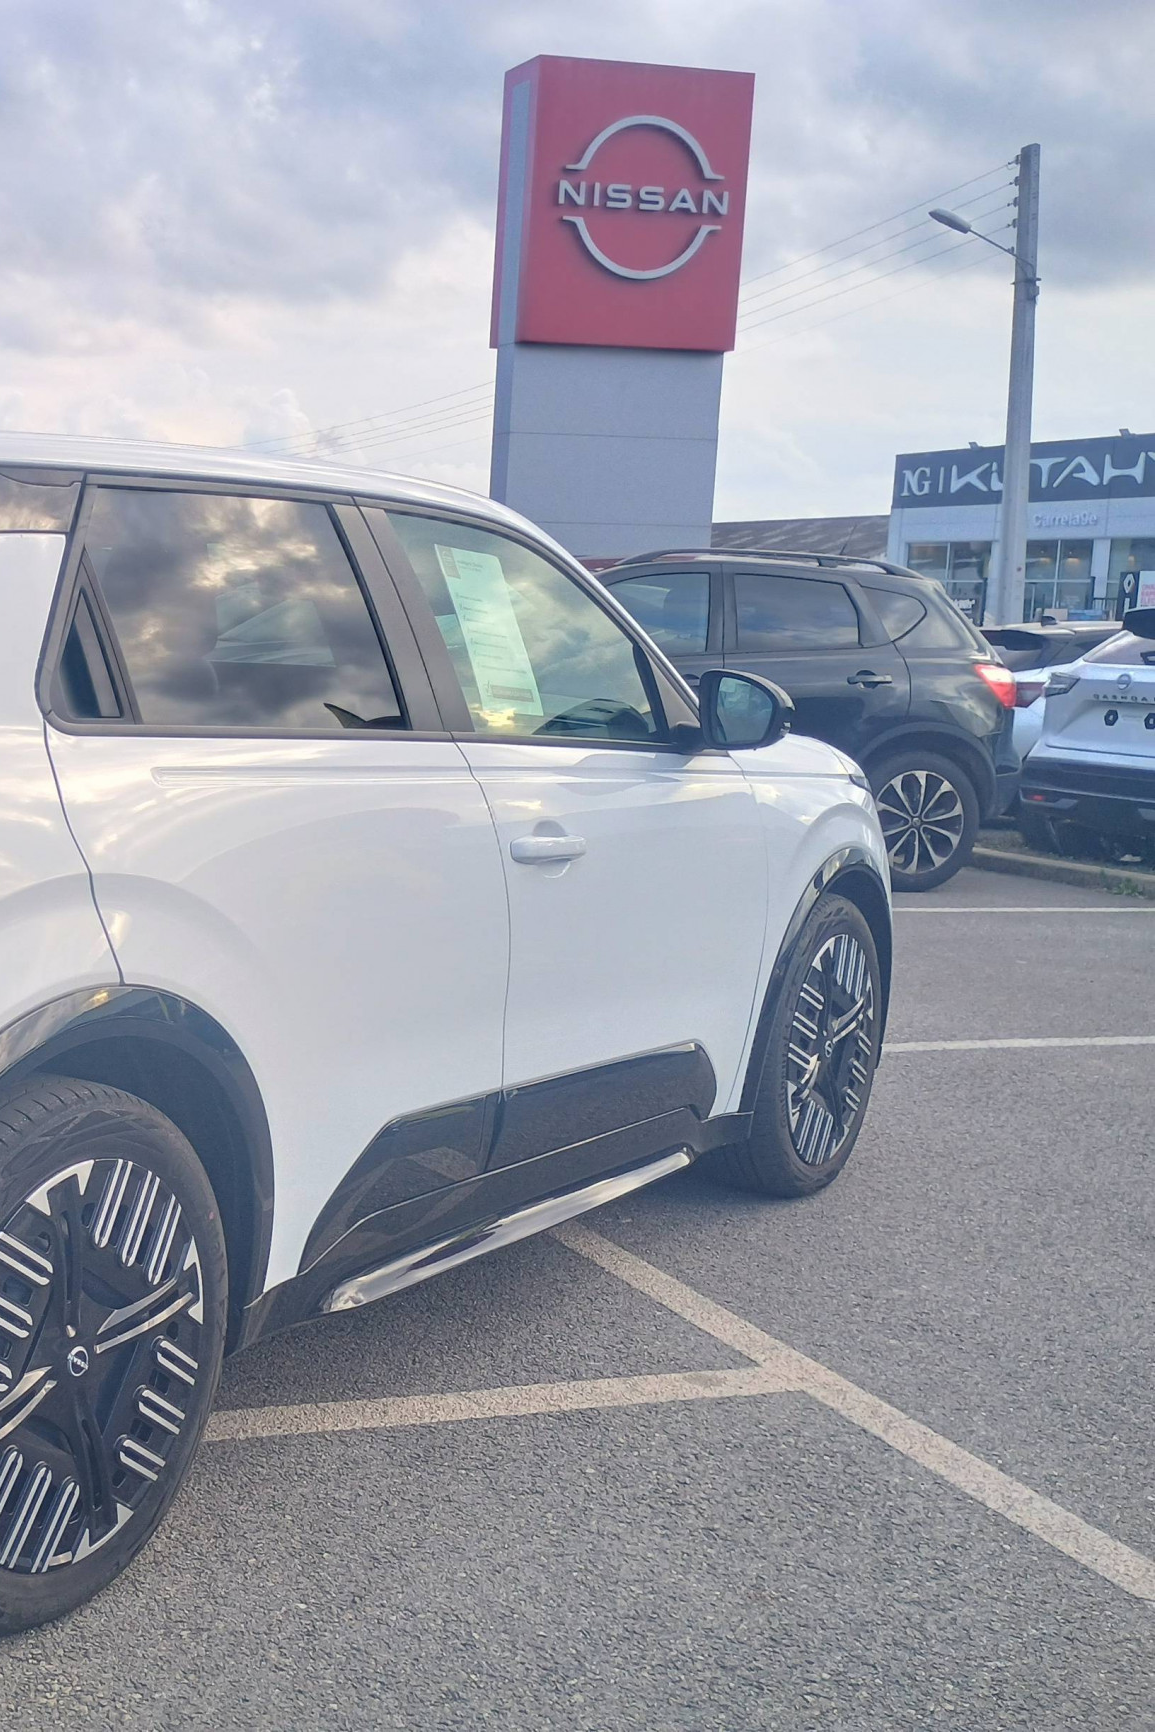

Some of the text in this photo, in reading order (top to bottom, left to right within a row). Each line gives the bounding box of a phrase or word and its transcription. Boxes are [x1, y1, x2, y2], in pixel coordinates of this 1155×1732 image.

[558, 179, 729, 216] NISSAN
[900, 467, 932, 496] NG
[1033, 511, 1098, 529] Carrelage
